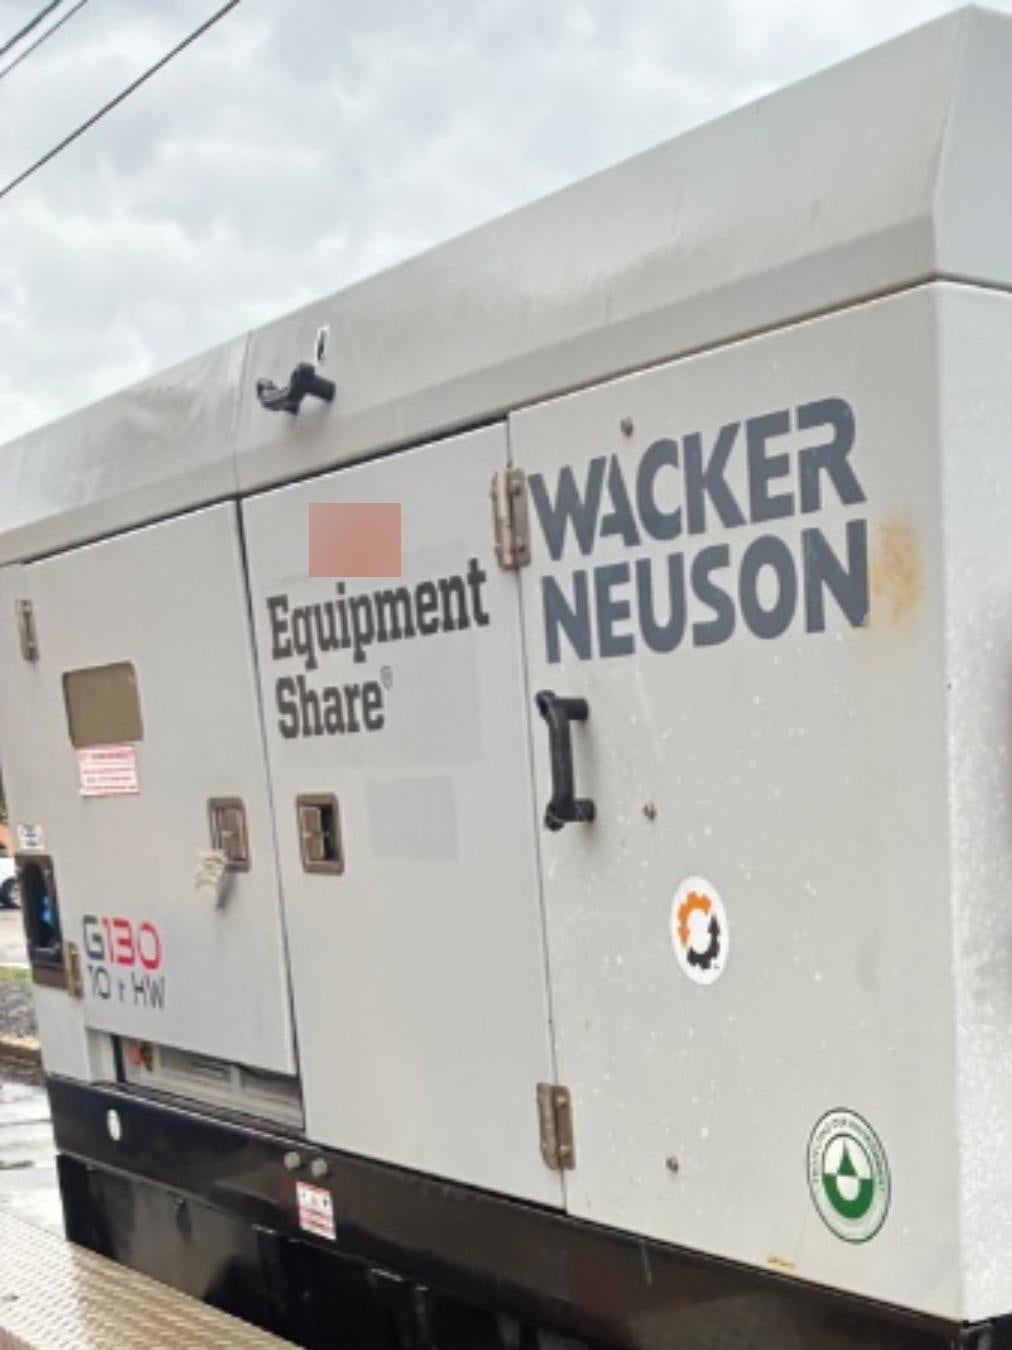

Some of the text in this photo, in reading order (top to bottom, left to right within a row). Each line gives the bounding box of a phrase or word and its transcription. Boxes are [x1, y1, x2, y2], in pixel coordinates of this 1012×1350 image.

[527, 396, 867, 561] WACKER
[266, 557, 490, 671] Equipment
[541, 518, 870, 665] NEUSON
[82, 913, 163, 971] G130
